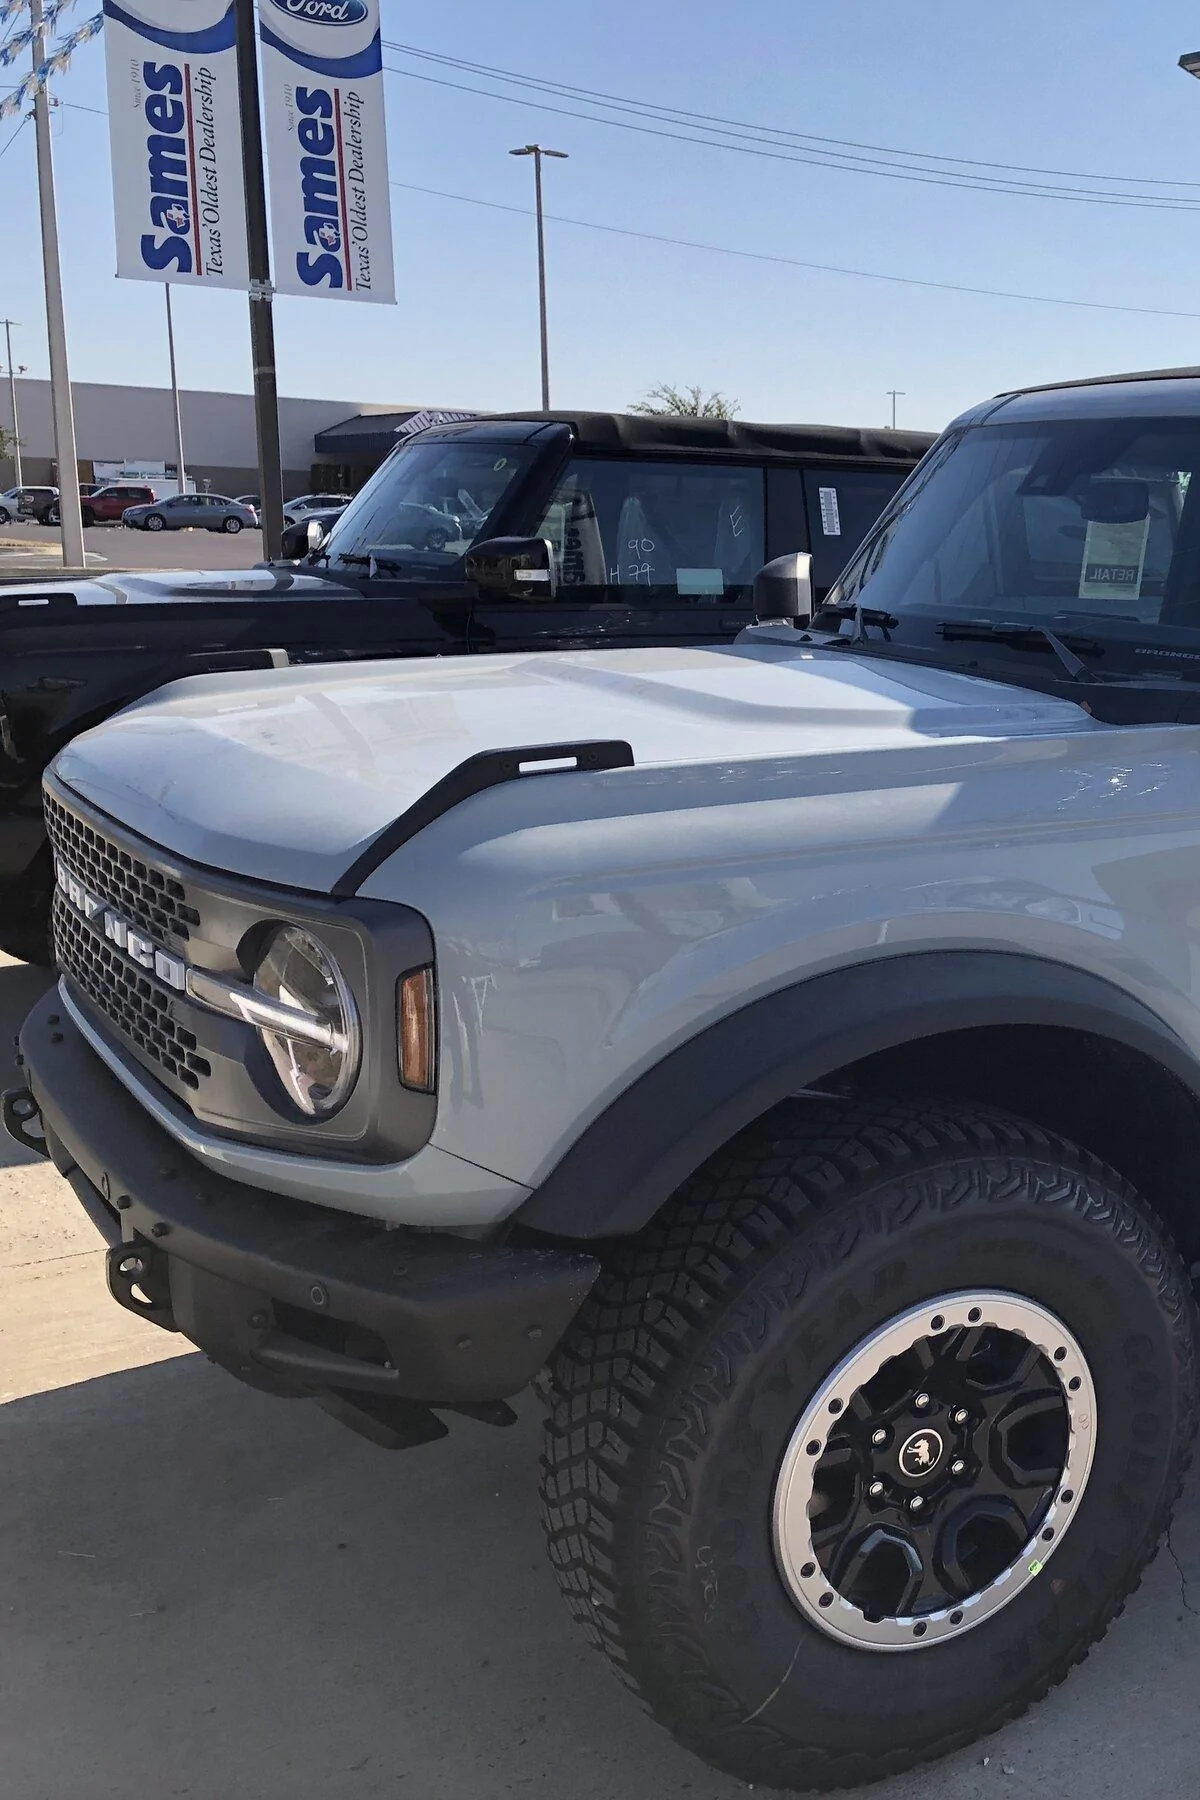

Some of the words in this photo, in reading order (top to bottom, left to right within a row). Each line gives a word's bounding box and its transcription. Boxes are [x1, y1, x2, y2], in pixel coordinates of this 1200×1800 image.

[194, 66, 218, 163] Dealership
[343, 91, 366, 185] Dealership
[140, 60, 193, 274] Sames
[199, 161, 220, 225] Oldest
[295, 86, 344, 289] Sames
[348, 187, 369, 242] Oldest
[627, 538, 655, 560] 90
